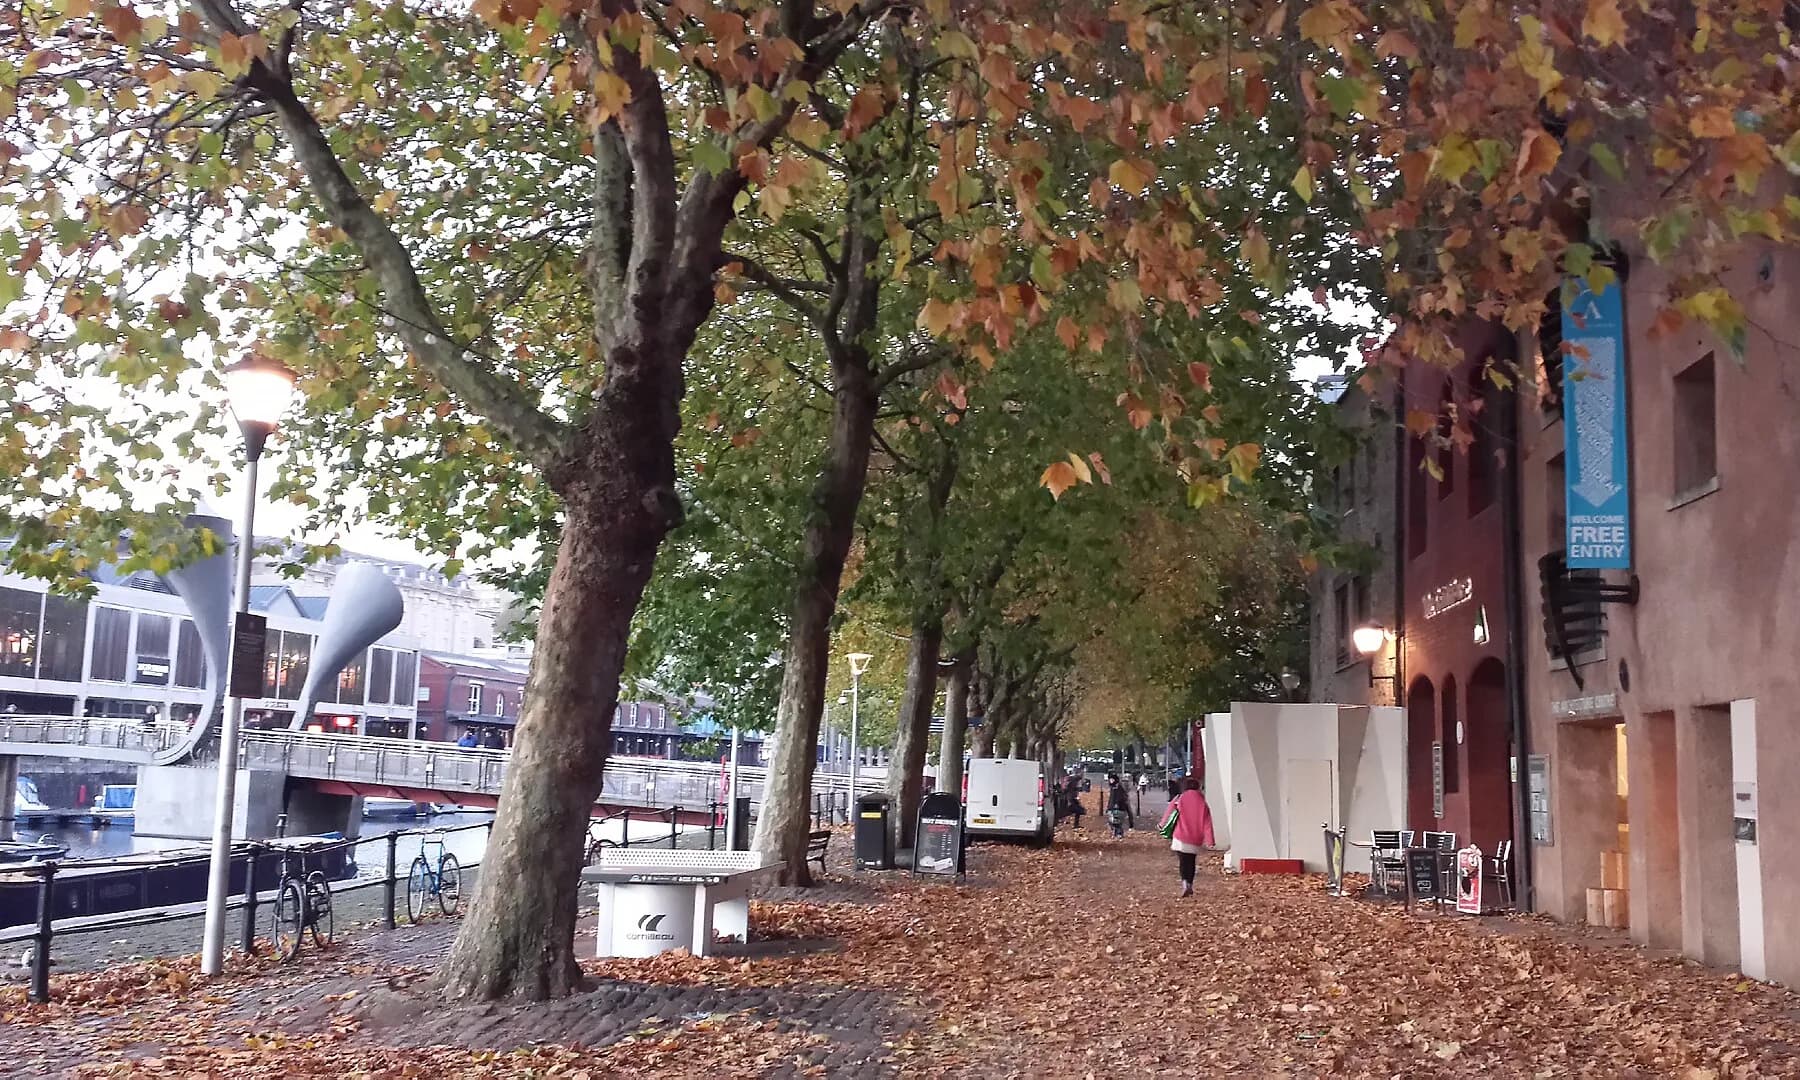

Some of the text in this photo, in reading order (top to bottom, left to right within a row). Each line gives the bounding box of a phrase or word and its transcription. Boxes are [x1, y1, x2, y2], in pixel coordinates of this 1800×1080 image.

[1571, 515, 1624, 524] WELCOME
[1571, 526, 1625, 543] FREE
[1571, 544, 1625, 558] ENTRY
